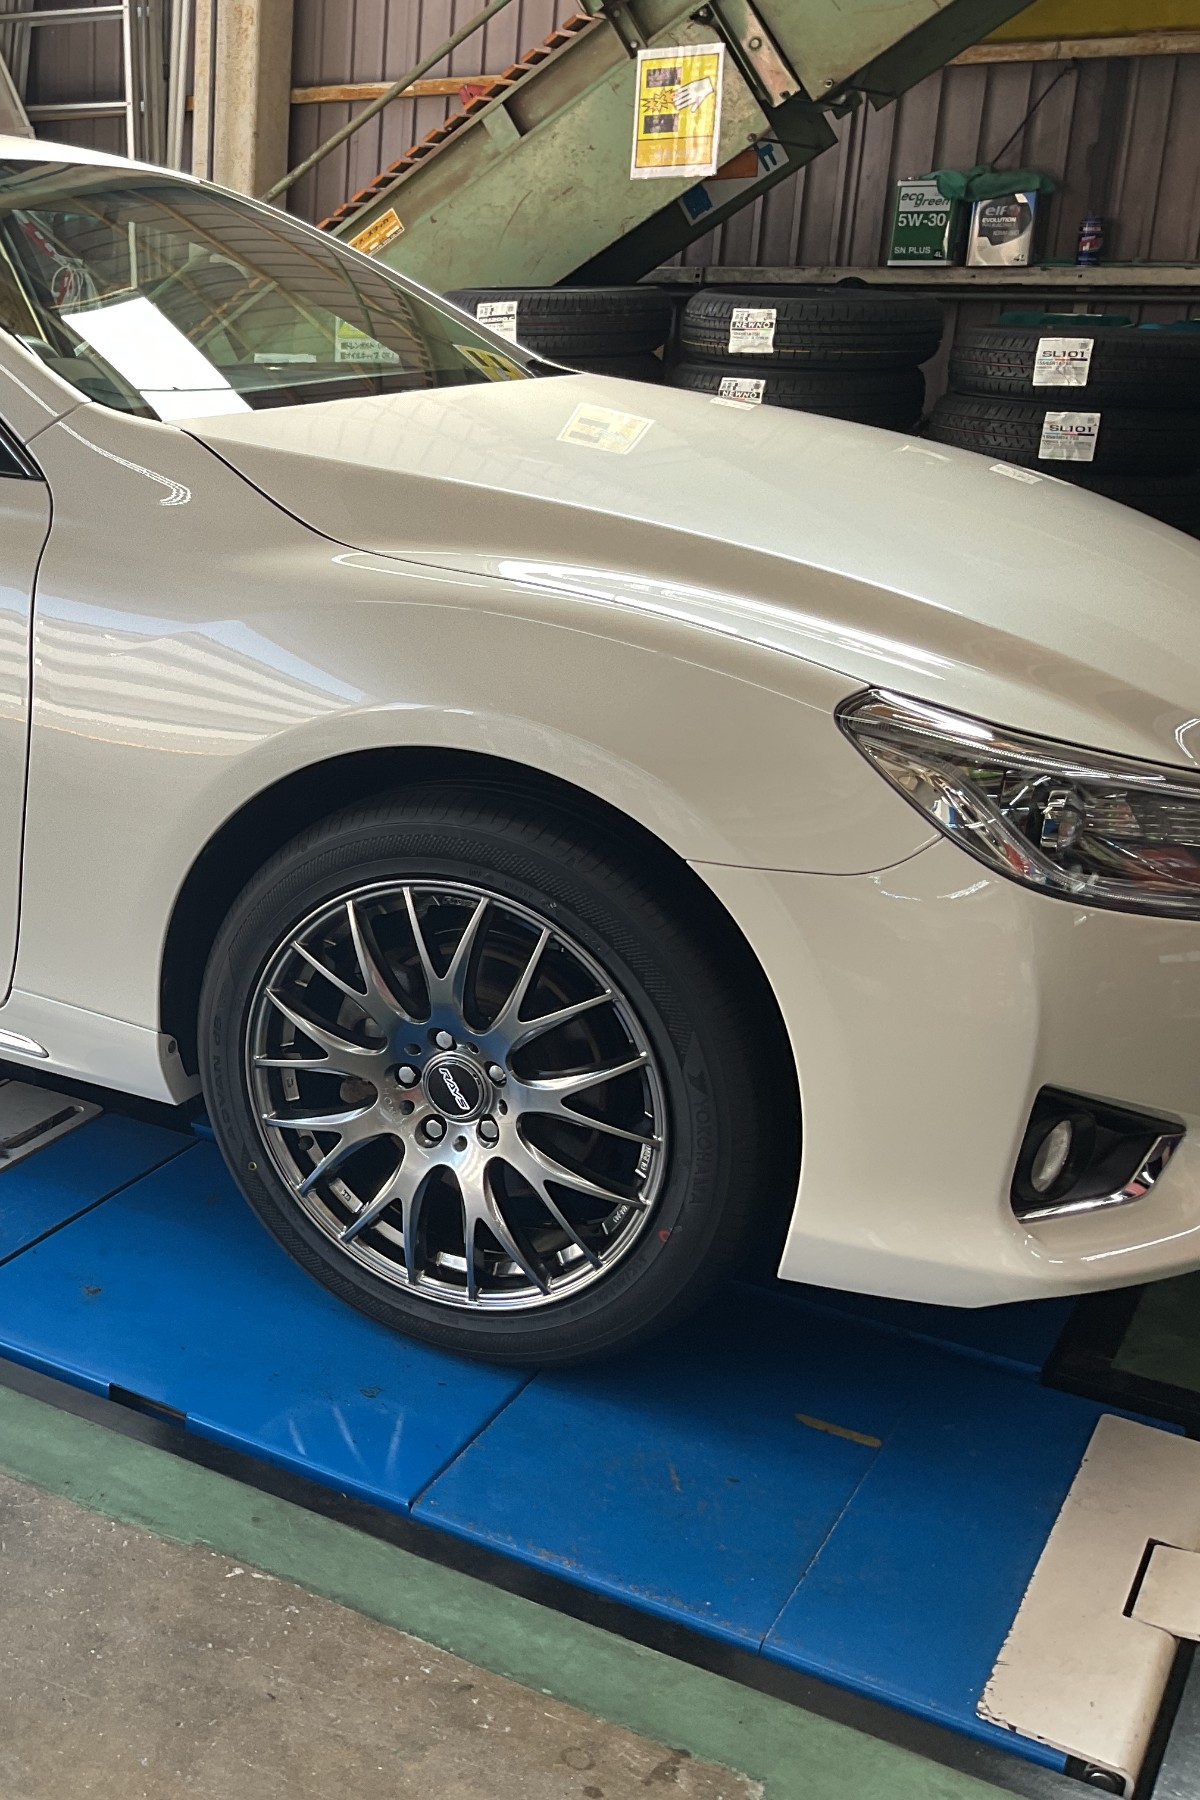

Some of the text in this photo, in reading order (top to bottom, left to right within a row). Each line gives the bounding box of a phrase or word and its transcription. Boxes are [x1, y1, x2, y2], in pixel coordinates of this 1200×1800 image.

[901, 192, 925, 201] eco
[914, 198, 950, 208] green
[985, 205, 1008, 215] elf
[898, 213, 947, 227] 5W-30
[894, 246, 931, 254] SN PLUS
[735, 321, 771, 329] NEWNO
[1042, 350, 1085, 358] SL101
[722, 390, 758, 398] NEWNO
[1049, 424, 1092, 433] SL101
[438, 1067, 471, 1111] RAYS
